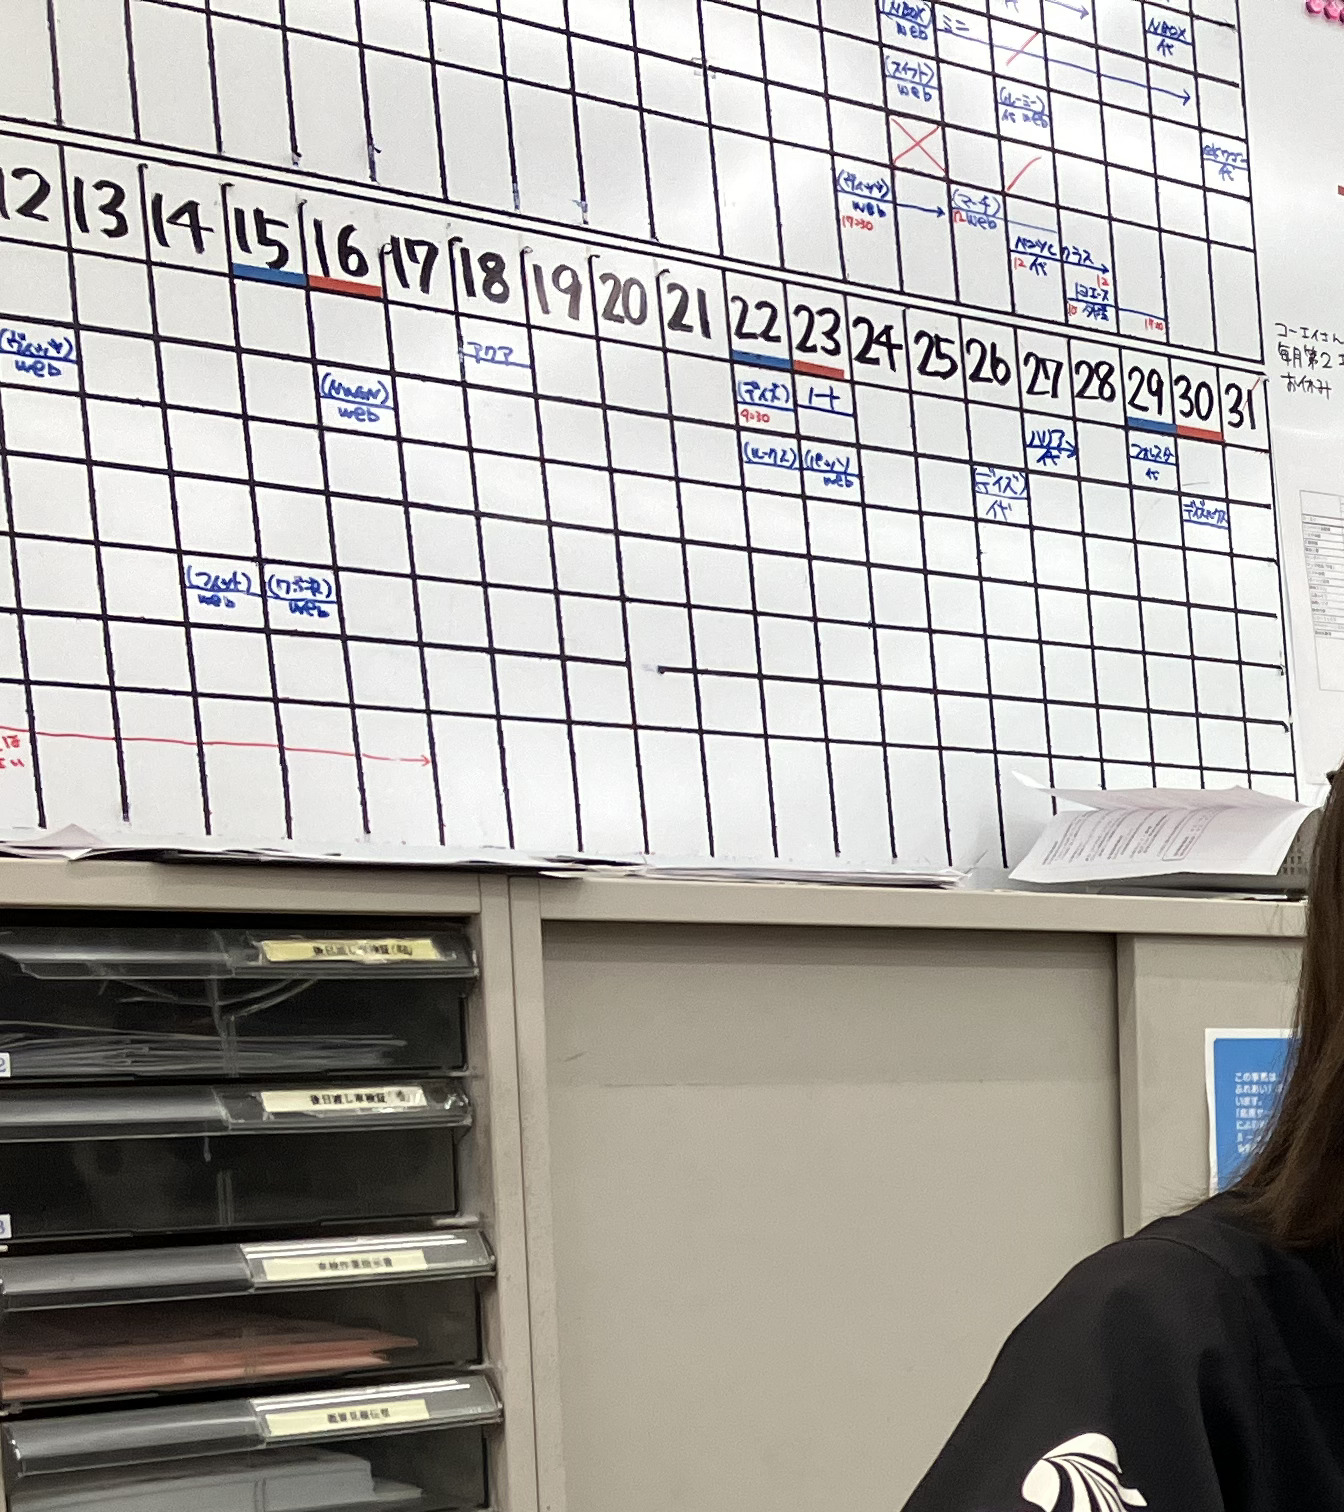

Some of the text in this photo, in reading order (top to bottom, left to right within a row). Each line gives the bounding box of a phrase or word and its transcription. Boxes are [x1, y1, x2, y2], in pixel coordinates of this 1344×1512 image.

[0, 166, 1259, 431] 12 13 14 15 16 17 18 19 20 21 22 23 24 25 26 27 28 29 30 31
[1274, 321, 1344, 345] コーエイさん
[13, 356, 63, 379] web
[1280, 372, 1333, 400] お休み
[335, 404, 382, 424] web
[288, 598, 332, 620] web
